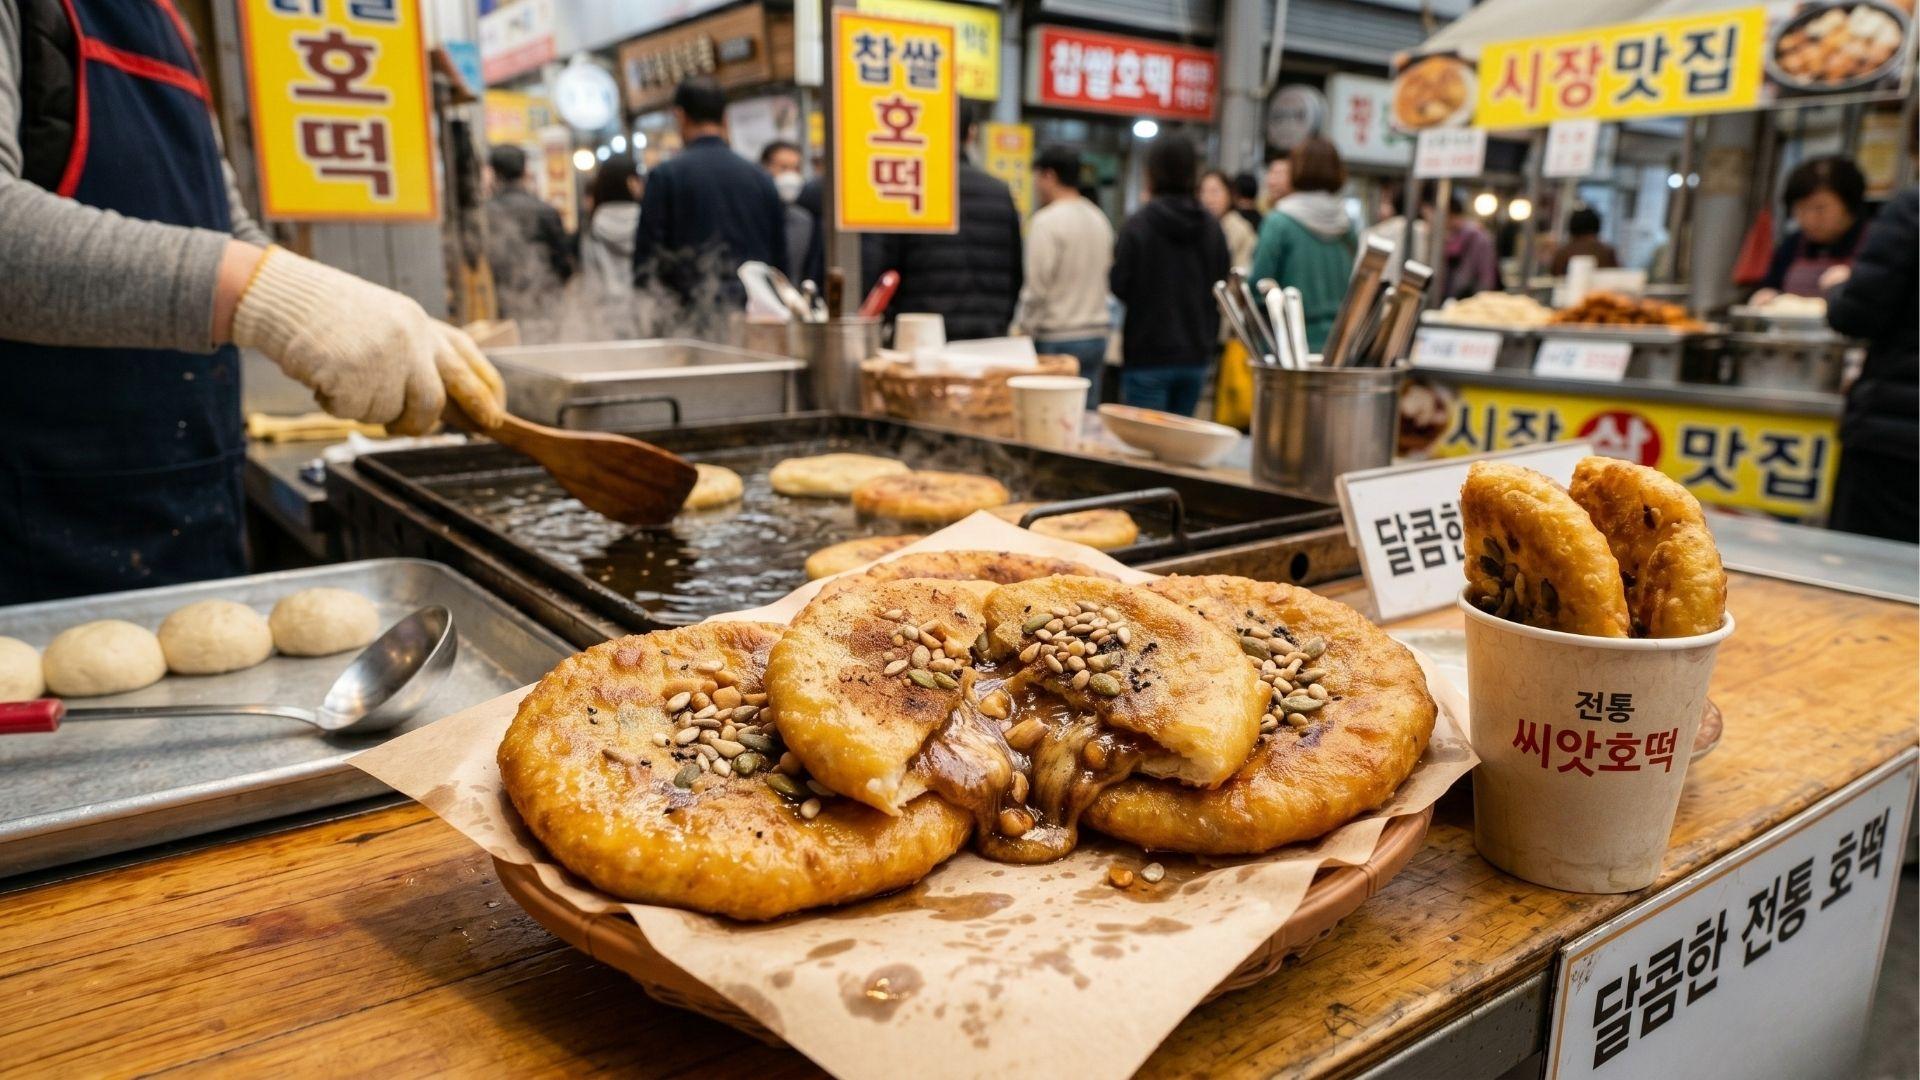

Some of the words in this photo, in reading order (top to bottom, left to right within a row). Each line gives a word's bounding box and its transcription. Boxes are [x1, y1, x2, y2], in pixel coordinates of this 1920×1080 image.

[855, 34, 941, 88] 찹쌀
[1493, 27, 1736, 112] 시장맛집
[1683, 425, 1825, 501] 맛집
[1574, 690, 1635, 724] 전통
[1512, 718, 1679, 778] 씨앗호떡
[1592, 908, 1729, 1071] 달콤한
[1741, 856, 1815, 968] 전통
[1820, 806, 1891, 911] 호떡
